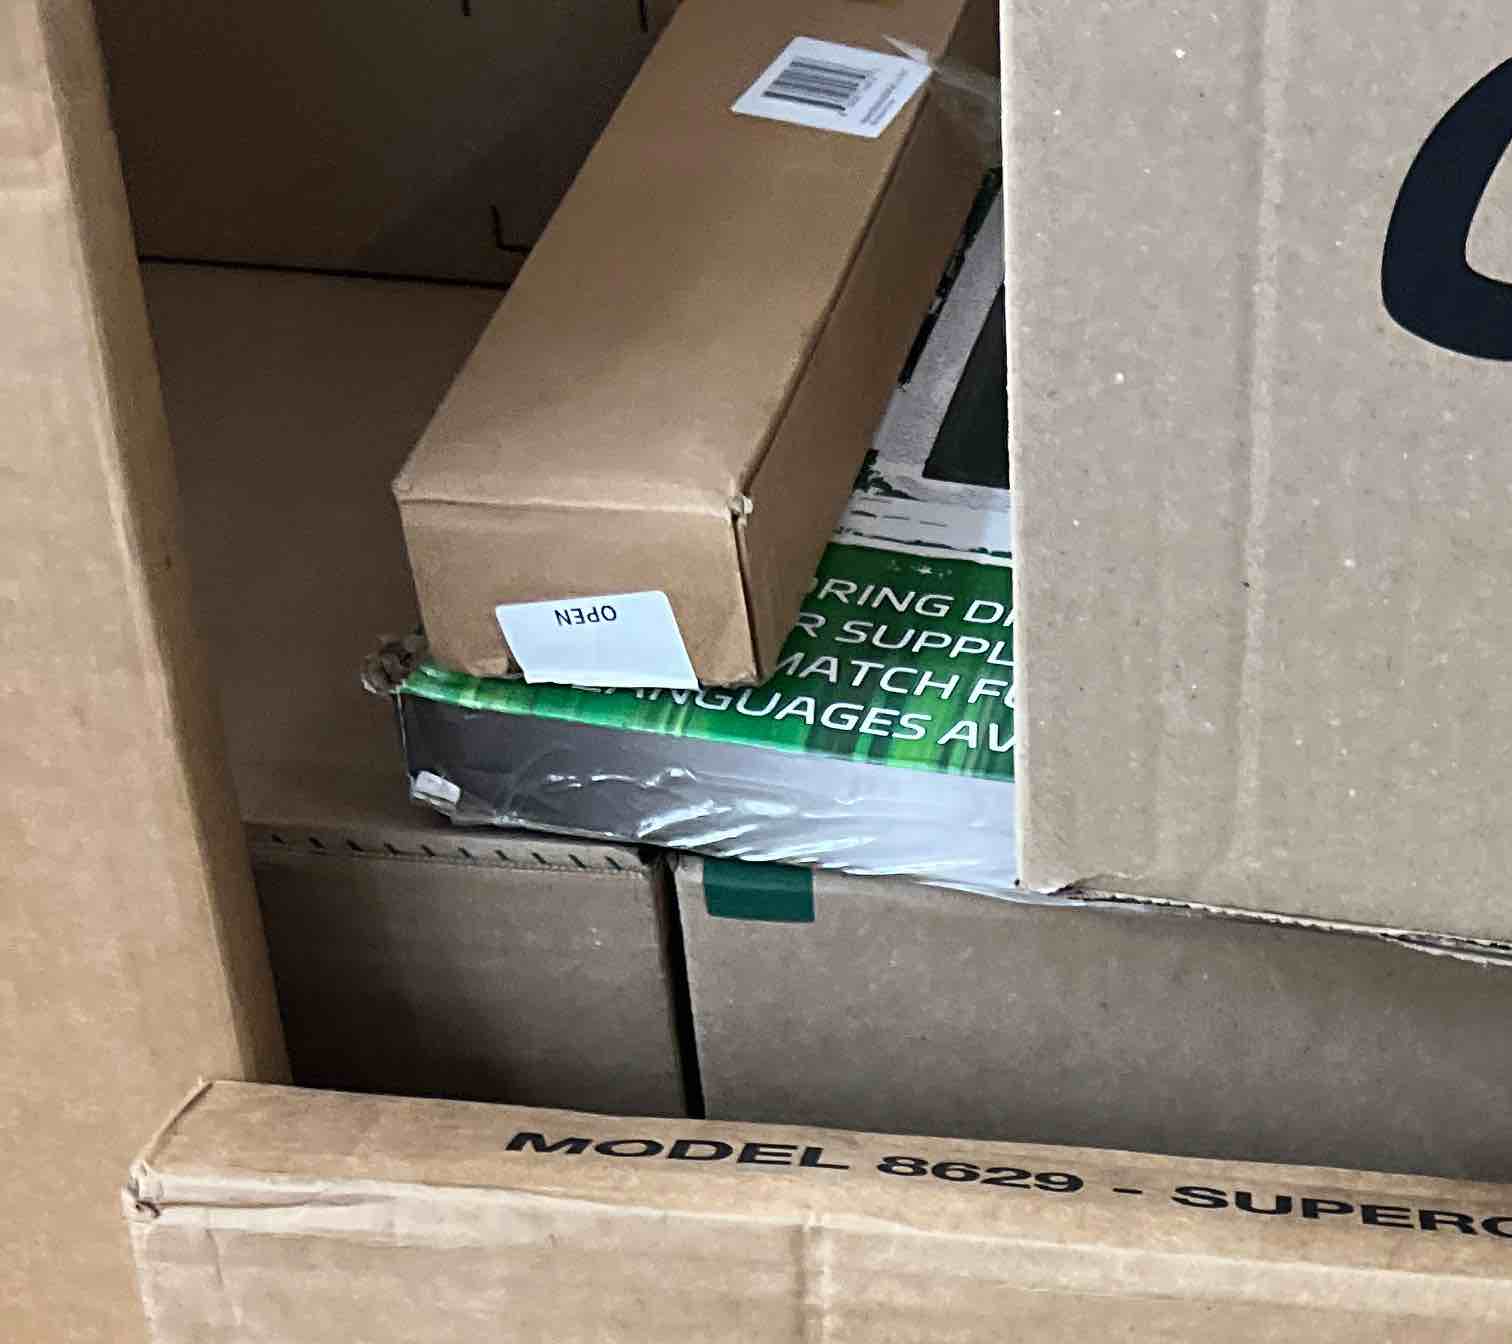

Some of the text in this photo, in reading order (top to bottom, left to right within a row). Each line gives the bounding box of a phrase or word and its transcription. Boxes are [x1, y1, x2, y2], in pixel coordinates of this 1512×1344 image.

[553, 605, 618, 626] OPEN
[809, 577, 955, 616] RING
[504, 1131, 849, 1170] MODEL
[876, 1156, 1084, 1193] 8629
